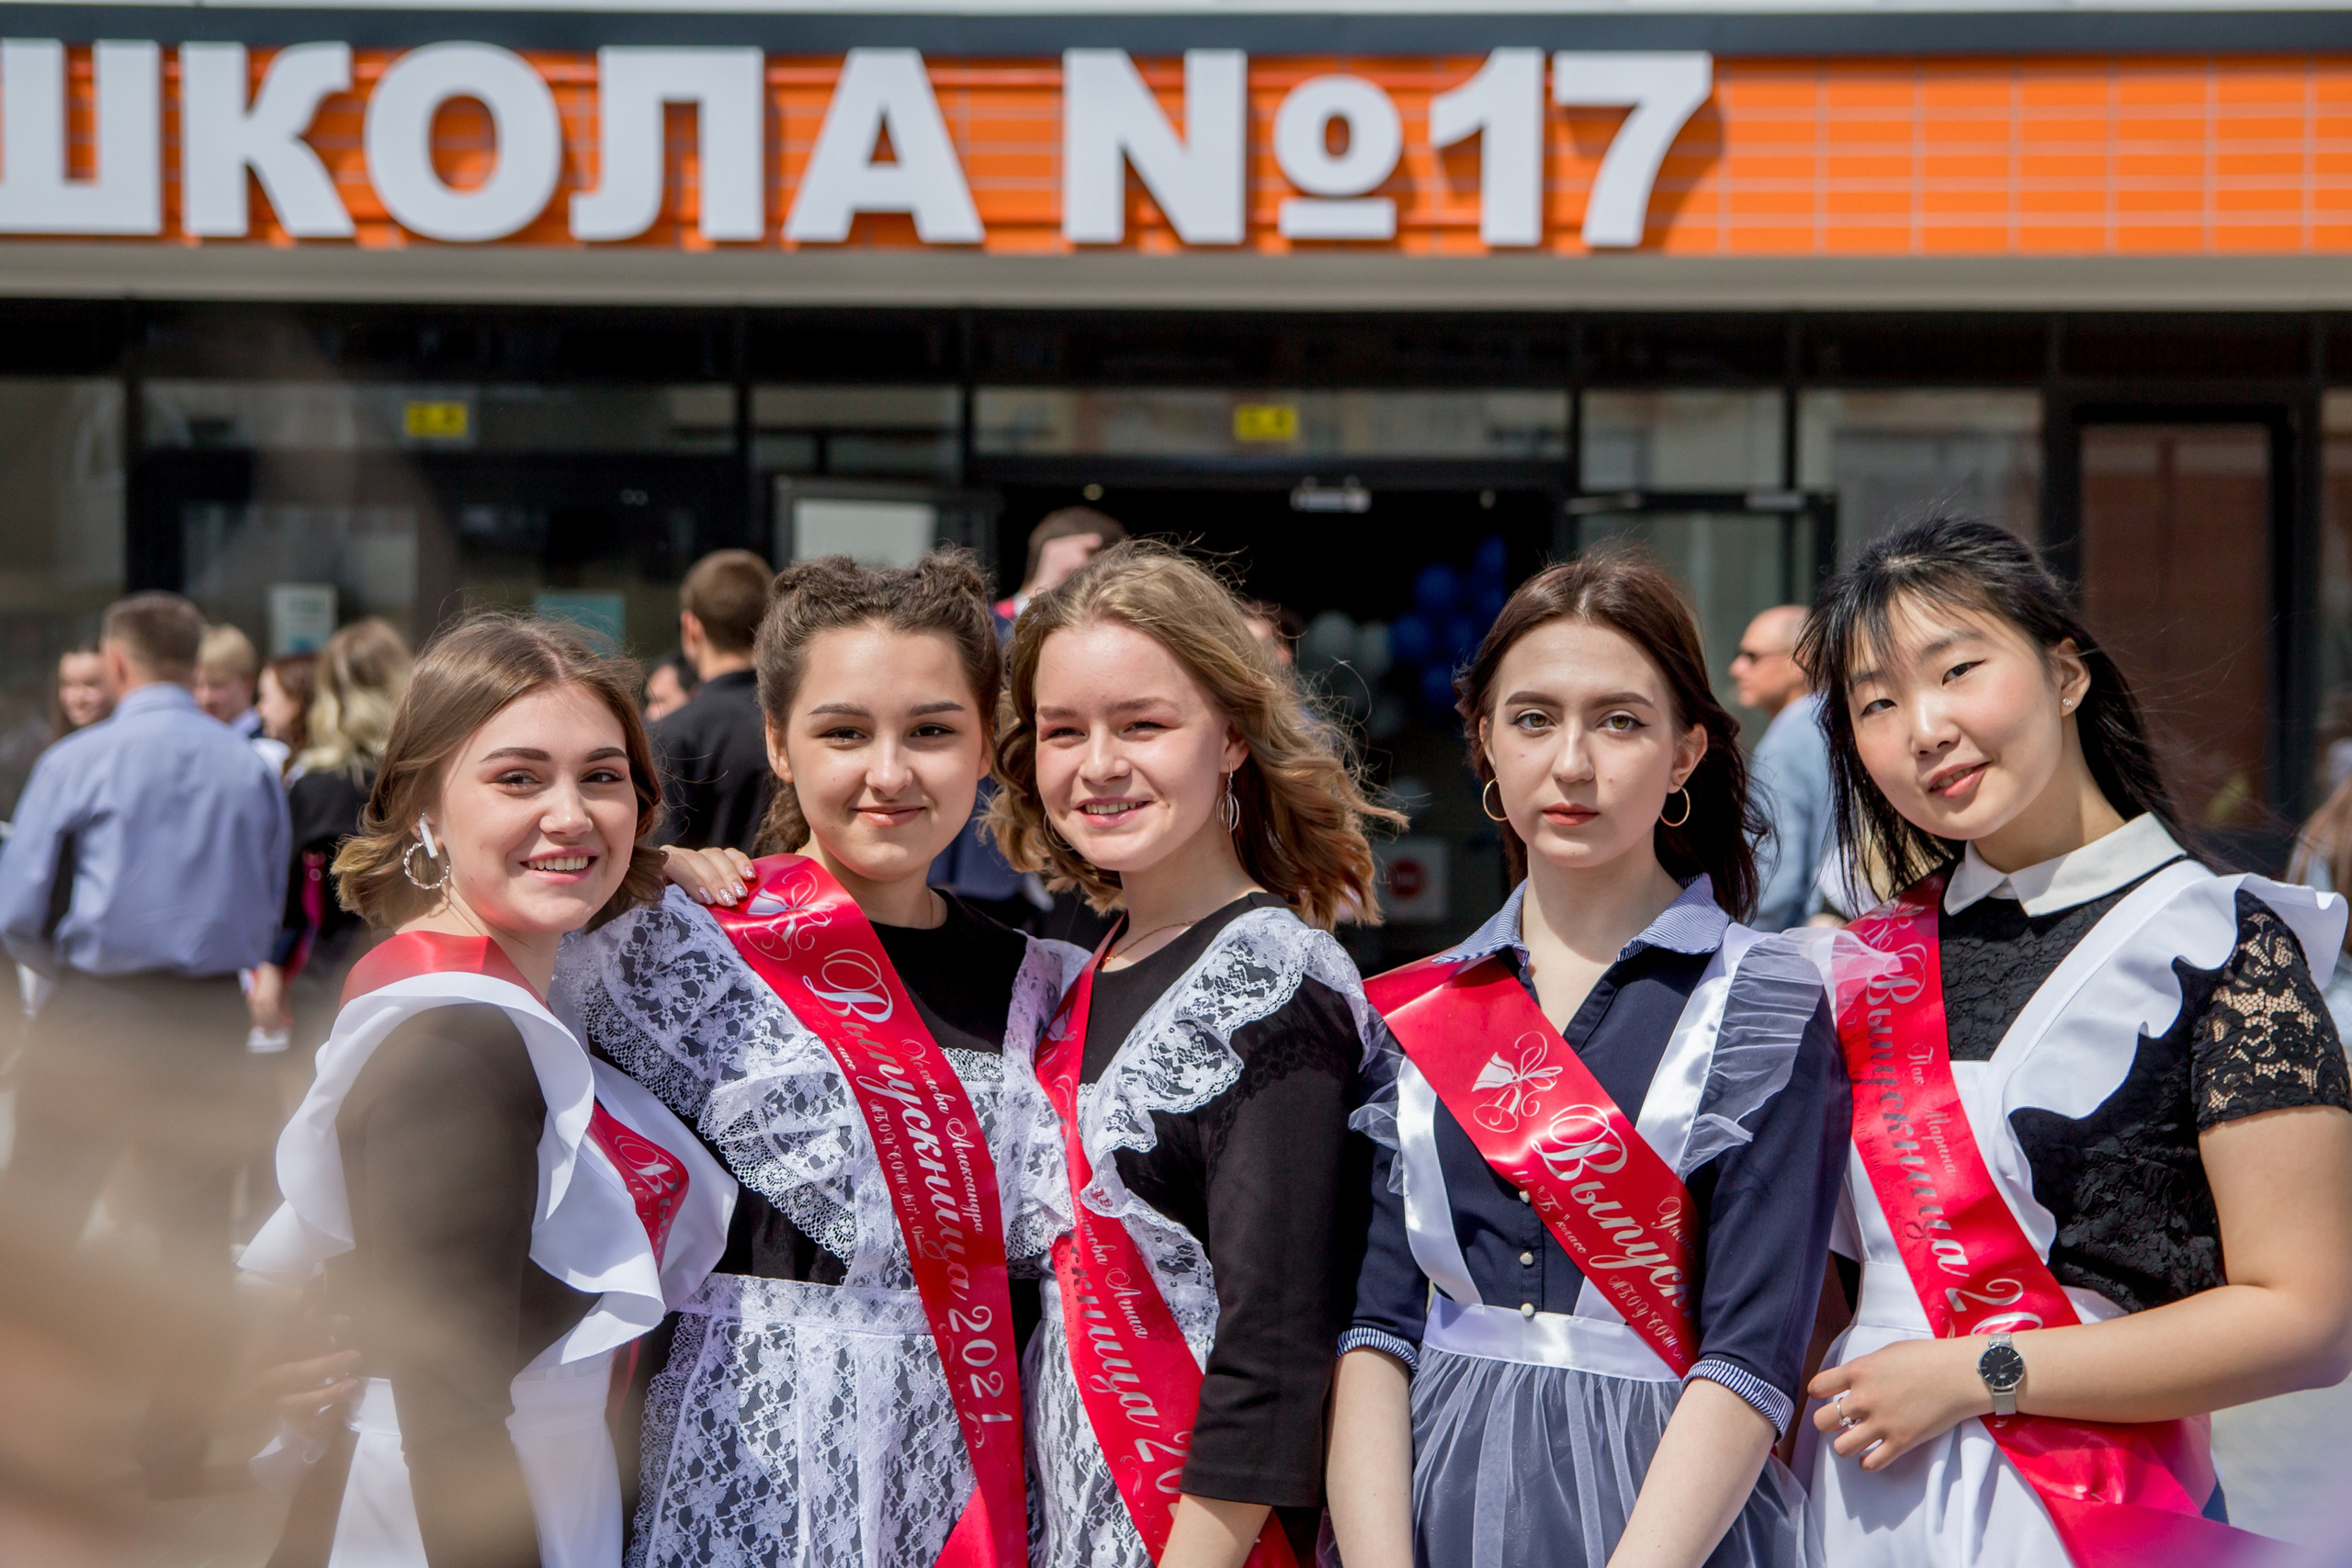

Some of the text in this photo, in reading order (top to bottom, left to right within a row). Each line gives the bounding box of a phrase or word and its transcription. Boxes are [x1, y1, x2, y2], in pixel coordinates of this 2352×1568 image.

[0, 39, 985, 244] ШКОЛА
[802, 949, 1012, 1422] Выпускница 2021
[868, 1098, 896, 1145] МБОУ
[946, 1117, 984, 1234] Александра
[1850, 943, 1970, 1278] Выпускница
[1945, 1278, 2044, 1337] 20
[1906, 1042, 1957, 1174] Пак Марина
[1070, 1246, 1159, 1427] скница
[1608, 1274, 1649, 1318] МБОУ
